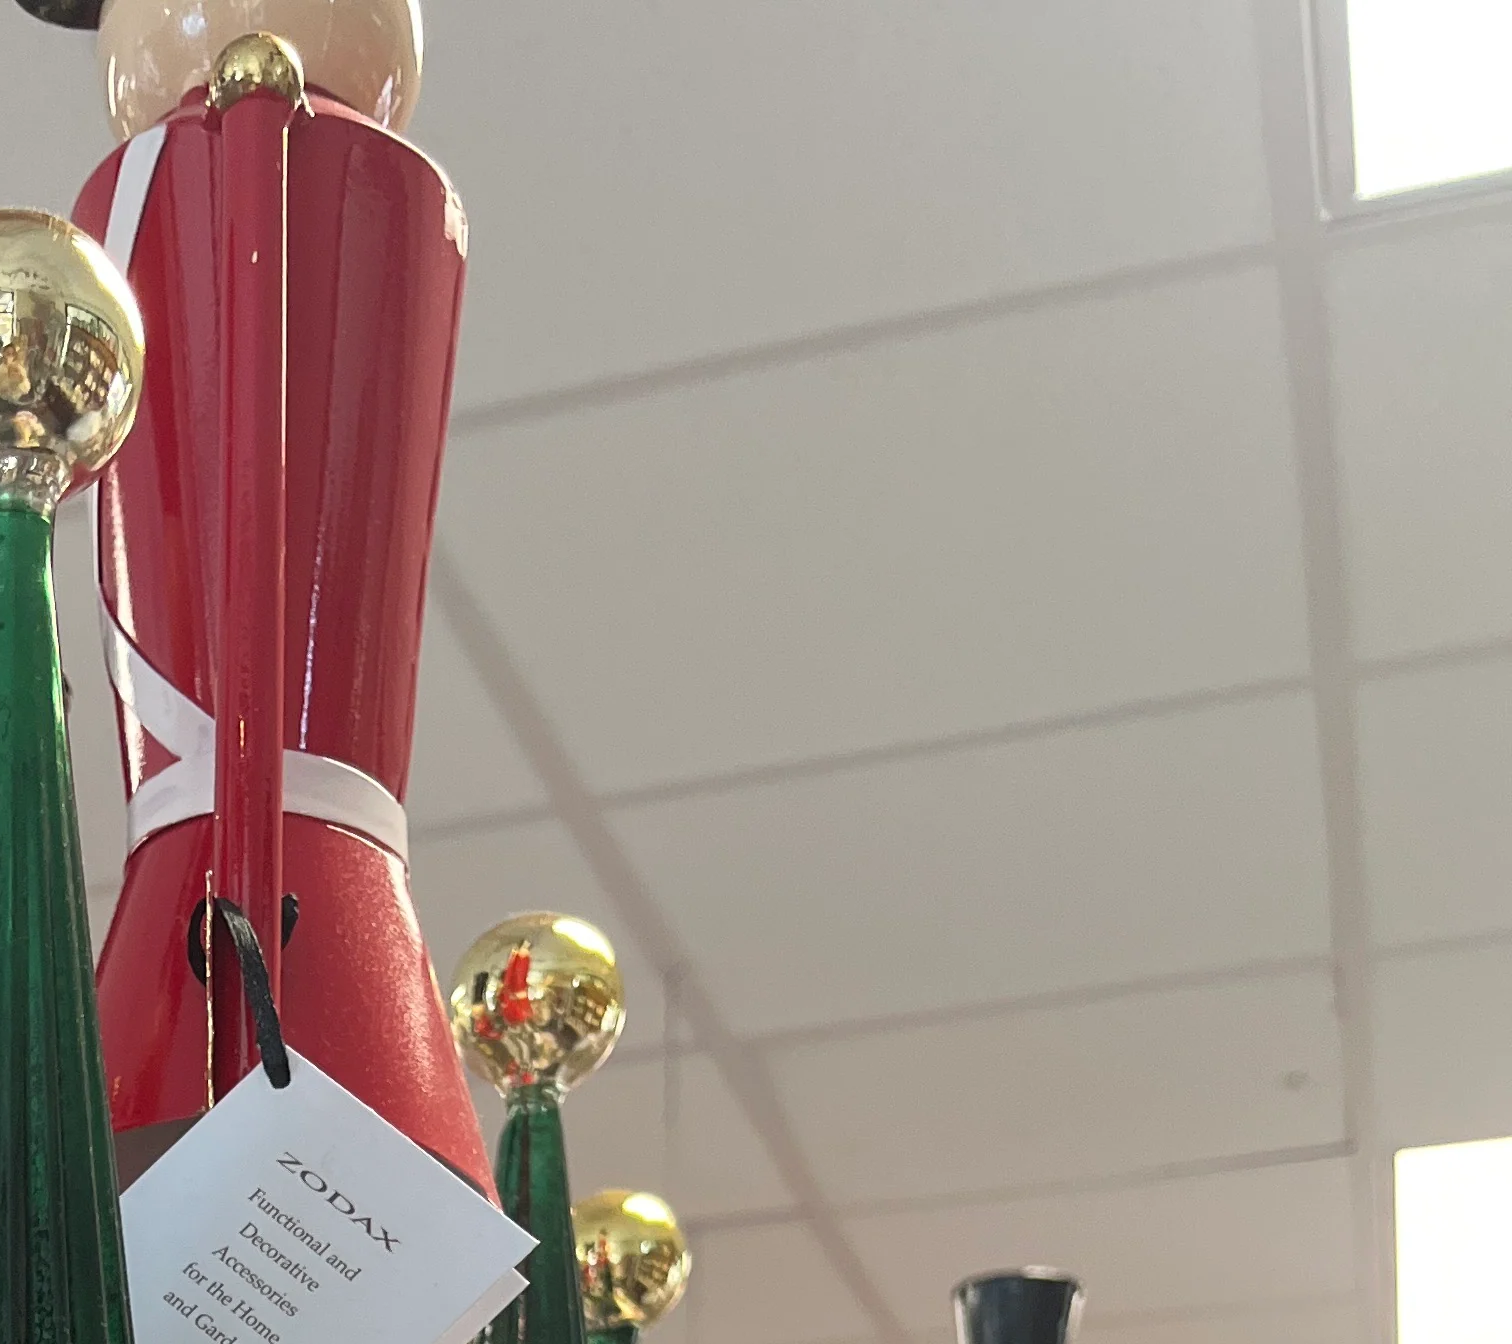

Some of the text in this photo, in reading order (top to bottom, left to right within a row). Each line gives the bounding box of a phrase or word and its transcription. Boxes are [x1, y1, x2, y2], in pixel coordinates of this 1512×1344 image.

[247, 1187, 363, 1283] Functional and
[276, 1151, 402, 1254] ZODAX
[182, 1261, 208, 1286] for
[207, 1279, 234, 1308] the
[211, 1244, 299, 1319] Accessories
[238, 1221, 321, 1294] Decorative
[162, 1289, 196, 1320] and
